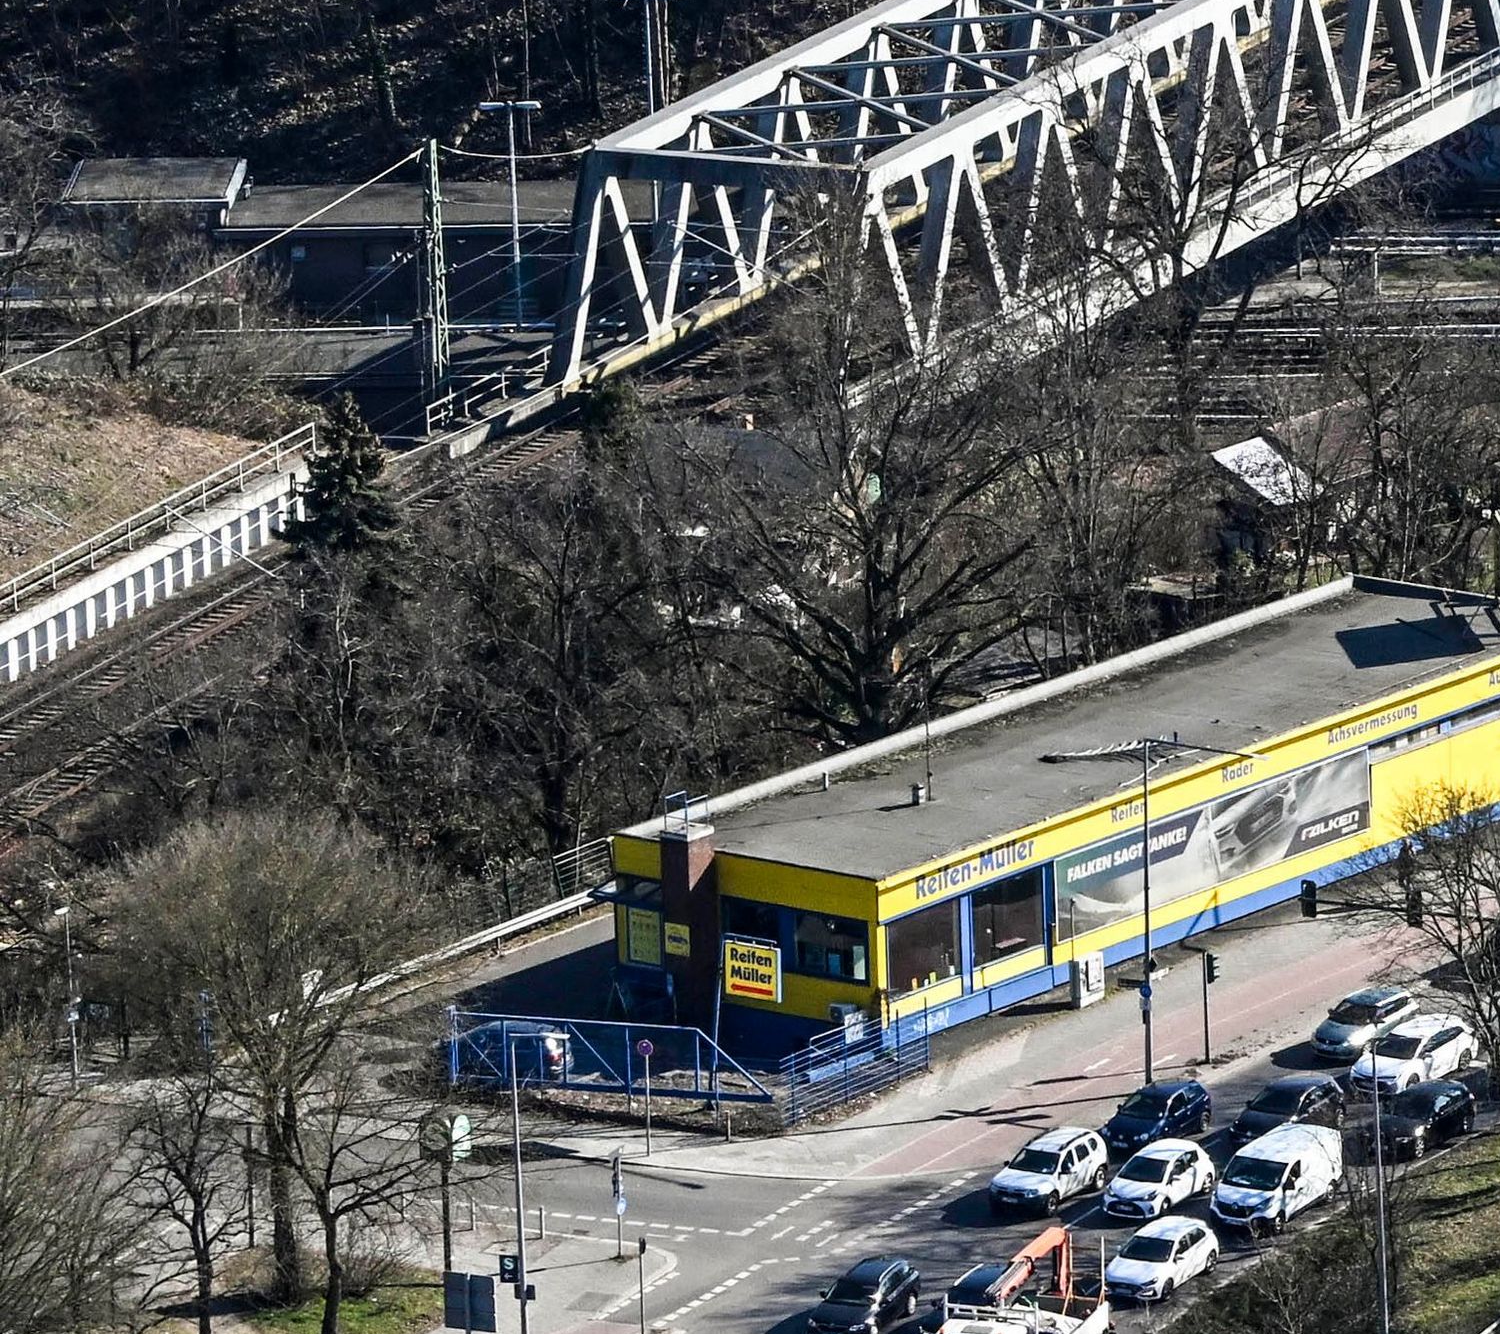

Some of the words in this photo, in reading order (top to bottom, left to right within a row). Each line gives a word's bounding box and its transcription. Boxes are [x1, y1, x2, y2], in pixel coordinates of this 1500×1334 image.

[1327, 703, 1419, 746] Achsvermessung
[1110, 801, 1146, 824] Reifen
[1302, 809, 1361, 843] FALKEN
[914, 838, 1035, 899] Reifen-Müller
[1066, 854, 1113, 883] FALKEN
[1113, 841, 1145, 867] SAGT
[730, 948, 772, 968] Reifen
[730, 965, 773, 985] Müller
[503, 1257, 514, 1270] S
